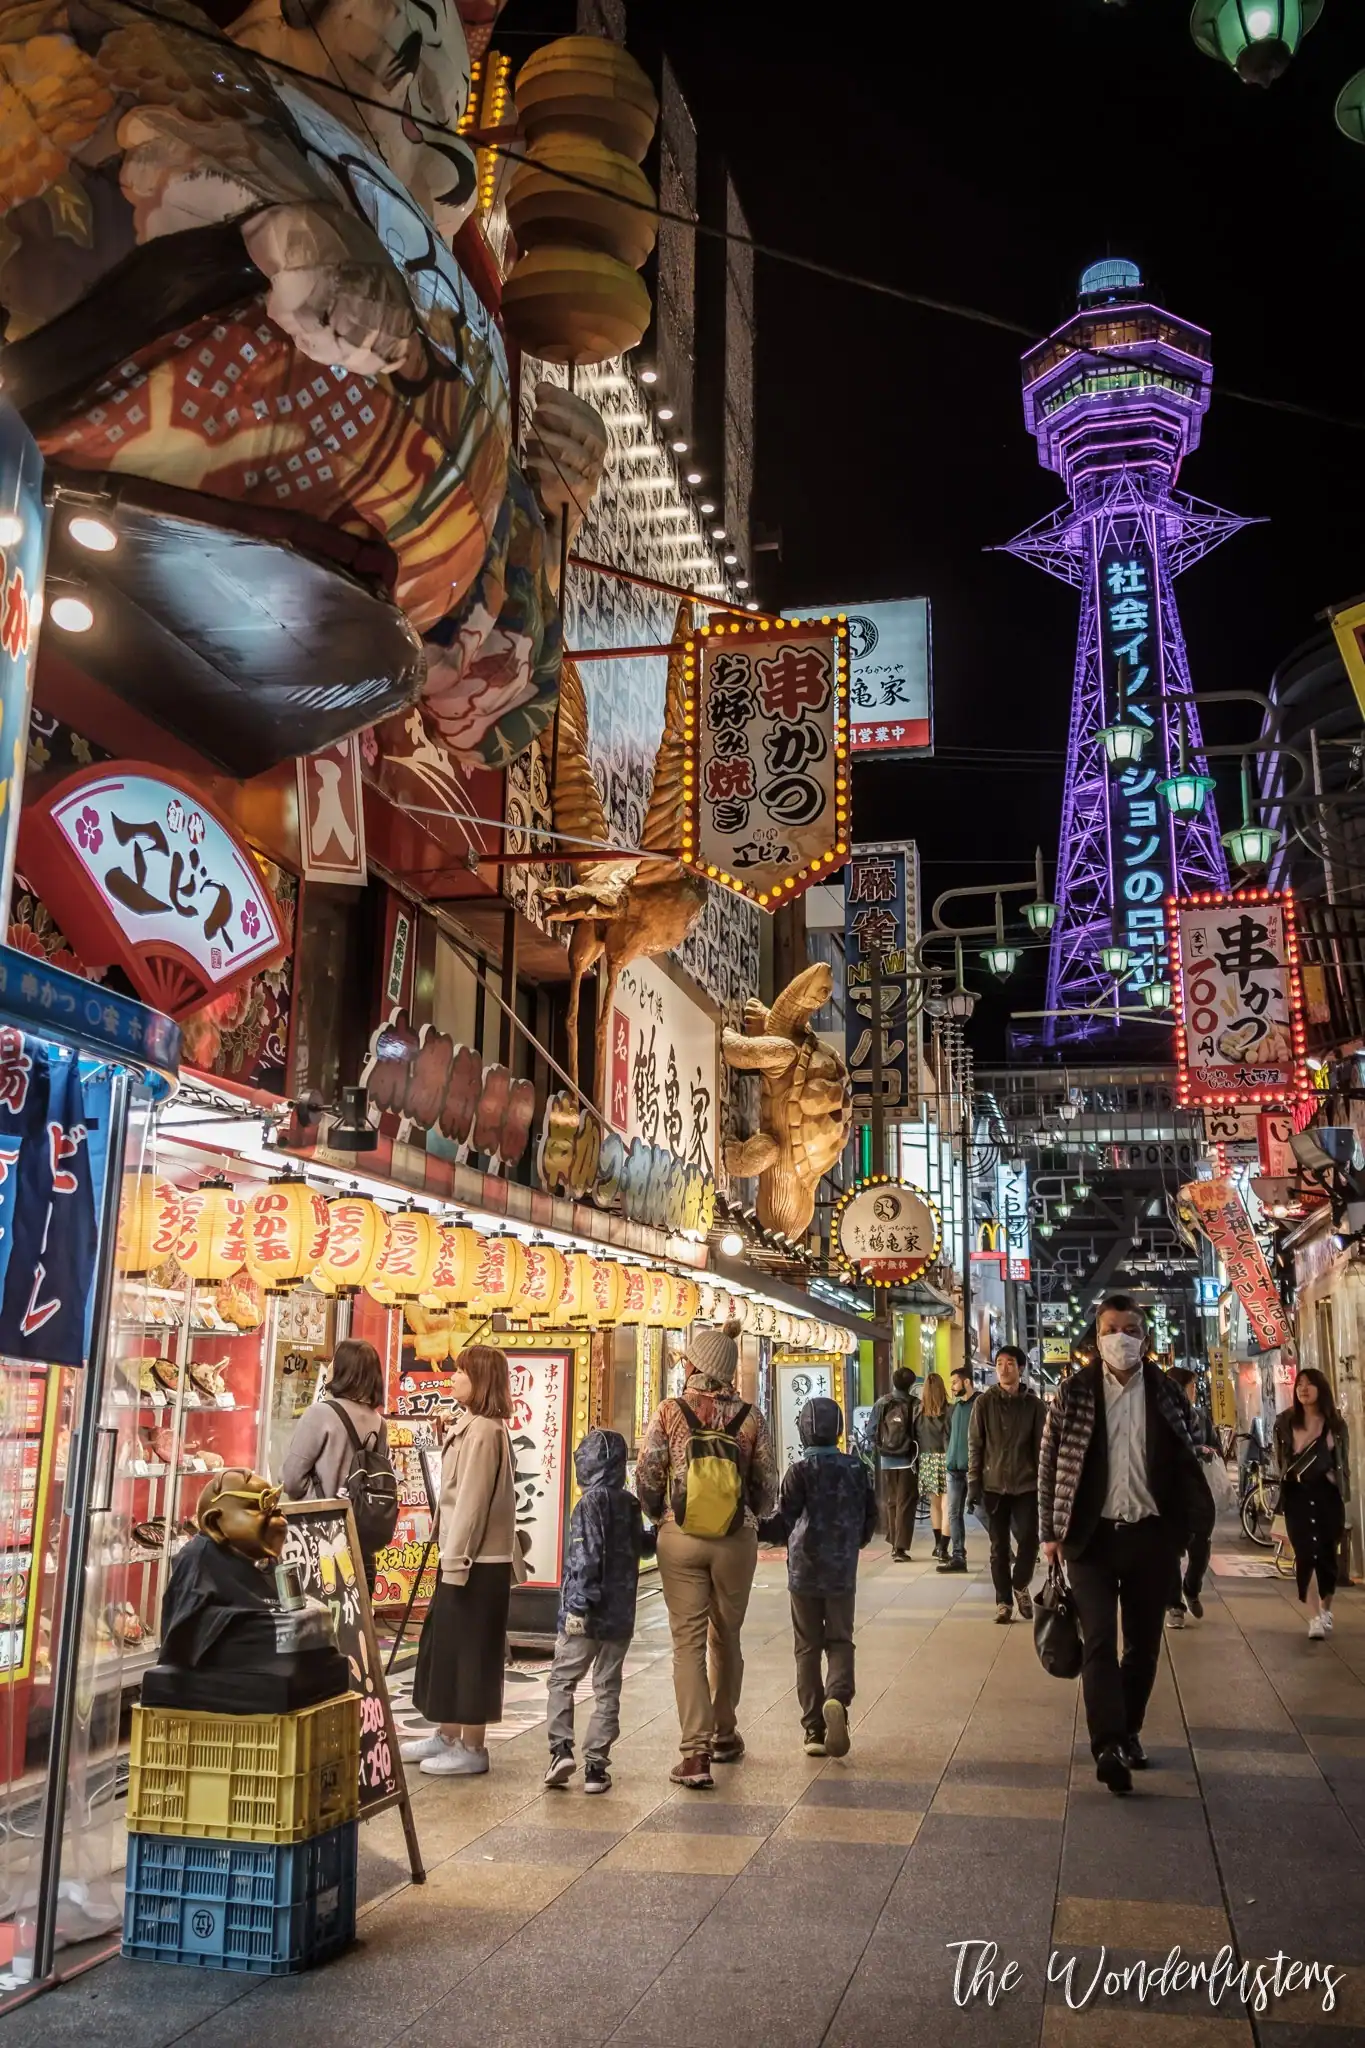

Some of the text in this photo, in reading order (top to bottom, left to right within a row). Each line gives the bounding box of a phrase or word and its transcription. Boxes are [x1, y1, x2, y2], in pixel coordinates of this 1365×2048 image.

[704, 654, 756, 833] お好み焼き
[755, 645, 831, 826] 串かつ
[849, 857, 899, 953] 麻雀
[848, 950, 906, 986] NW
[1215, 915, 1283, 1048] 串かつ
[849, 986, 904, 1106] マルコ
[20, 1122, 87, 1337] ビール
[252, 1195, 291, 1261] いか玉
[329, 1206, 365, 1267] モダン
[387, 1220, 418, 1276] ミックス
[367, 1743, 392, 1788] 290
